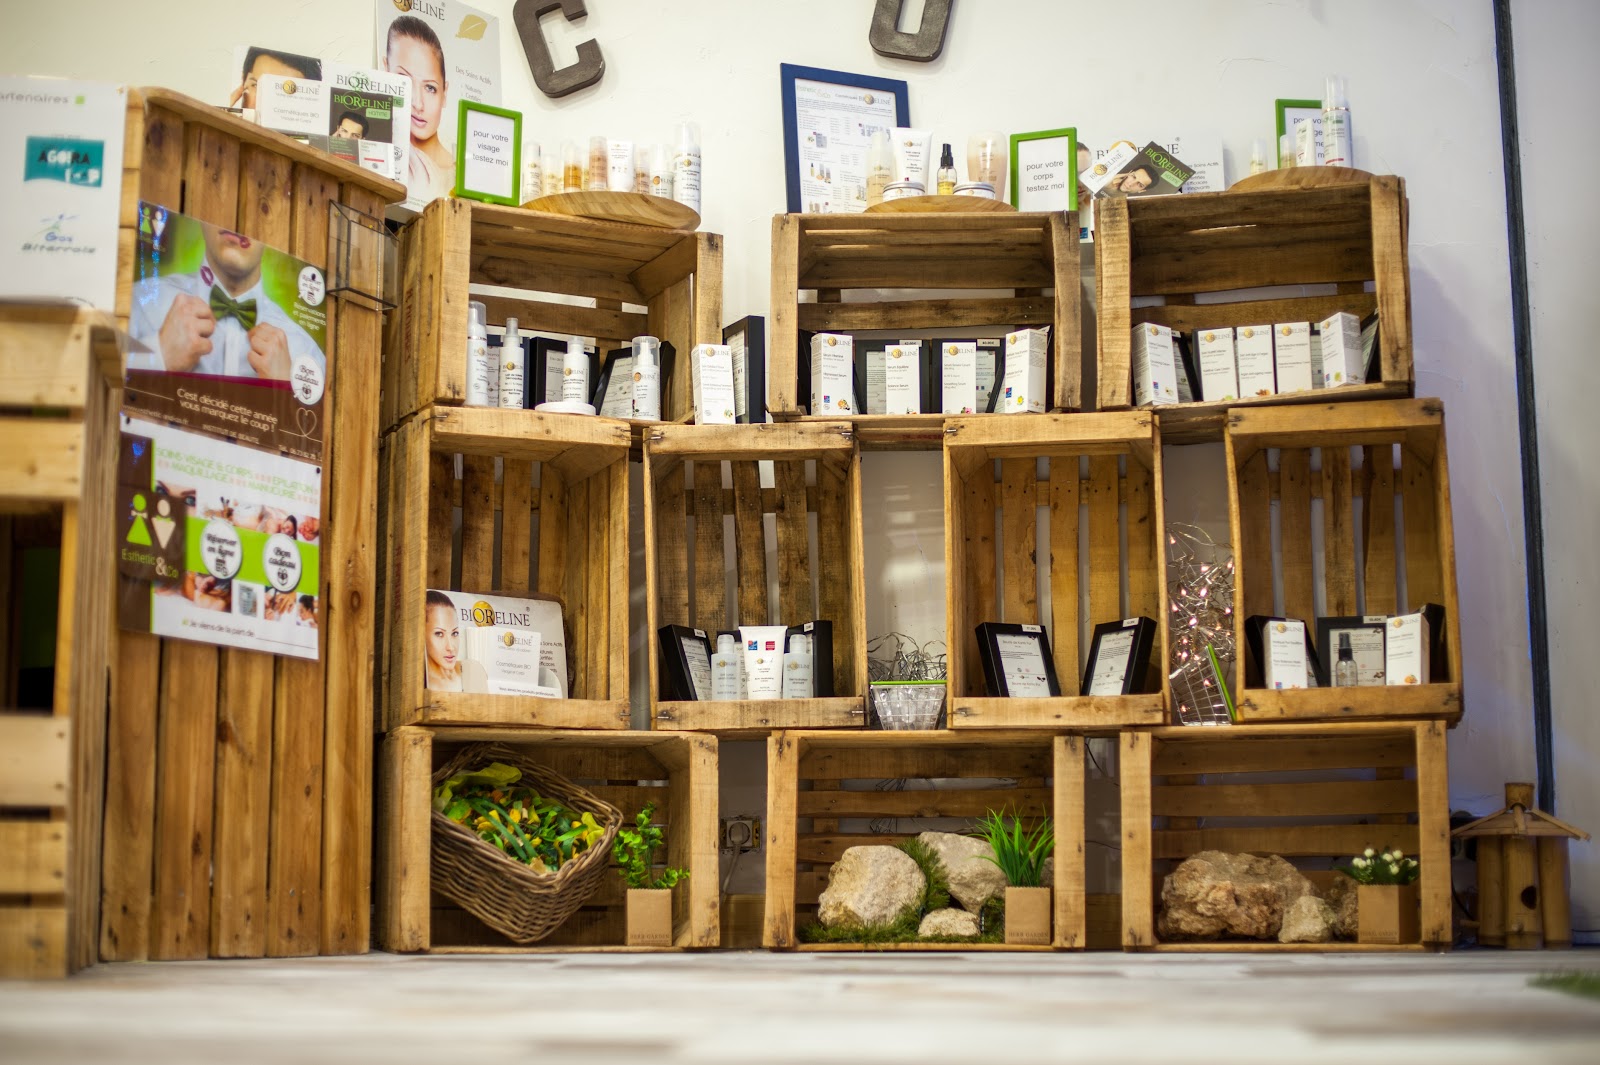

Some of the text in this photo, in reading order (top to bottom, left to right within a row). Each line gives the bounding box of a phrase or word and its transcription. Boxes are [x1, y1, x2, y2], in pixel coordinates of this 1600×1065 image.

[275, 82, 320, 95] BIORELINE
[336, 74, 405, 96] BIORELINE
[333, 94, 396, 109] BIORELINE
[473, 130, 509, 143] pour votre
[477, 142, 500, 154] visage
[473, 153, 509, 167] testez moi
[1026, 160, 1064, 172] pour votre
[1145, 147, 1188, 181] BIORELINE
[1033, 173, 1054, 181] corps
[1026, 181, 1065, 193] testez moi
[179, 400, 200, 412] vous
[201, 405, 239, 423] marquez
[249, 419, 270, 433] coup
[460, 607, 531, 627] BIORELINE
[497, 633, 532, 647] BIORELINE
[496, 660, 523, 669] Cosmétiques
